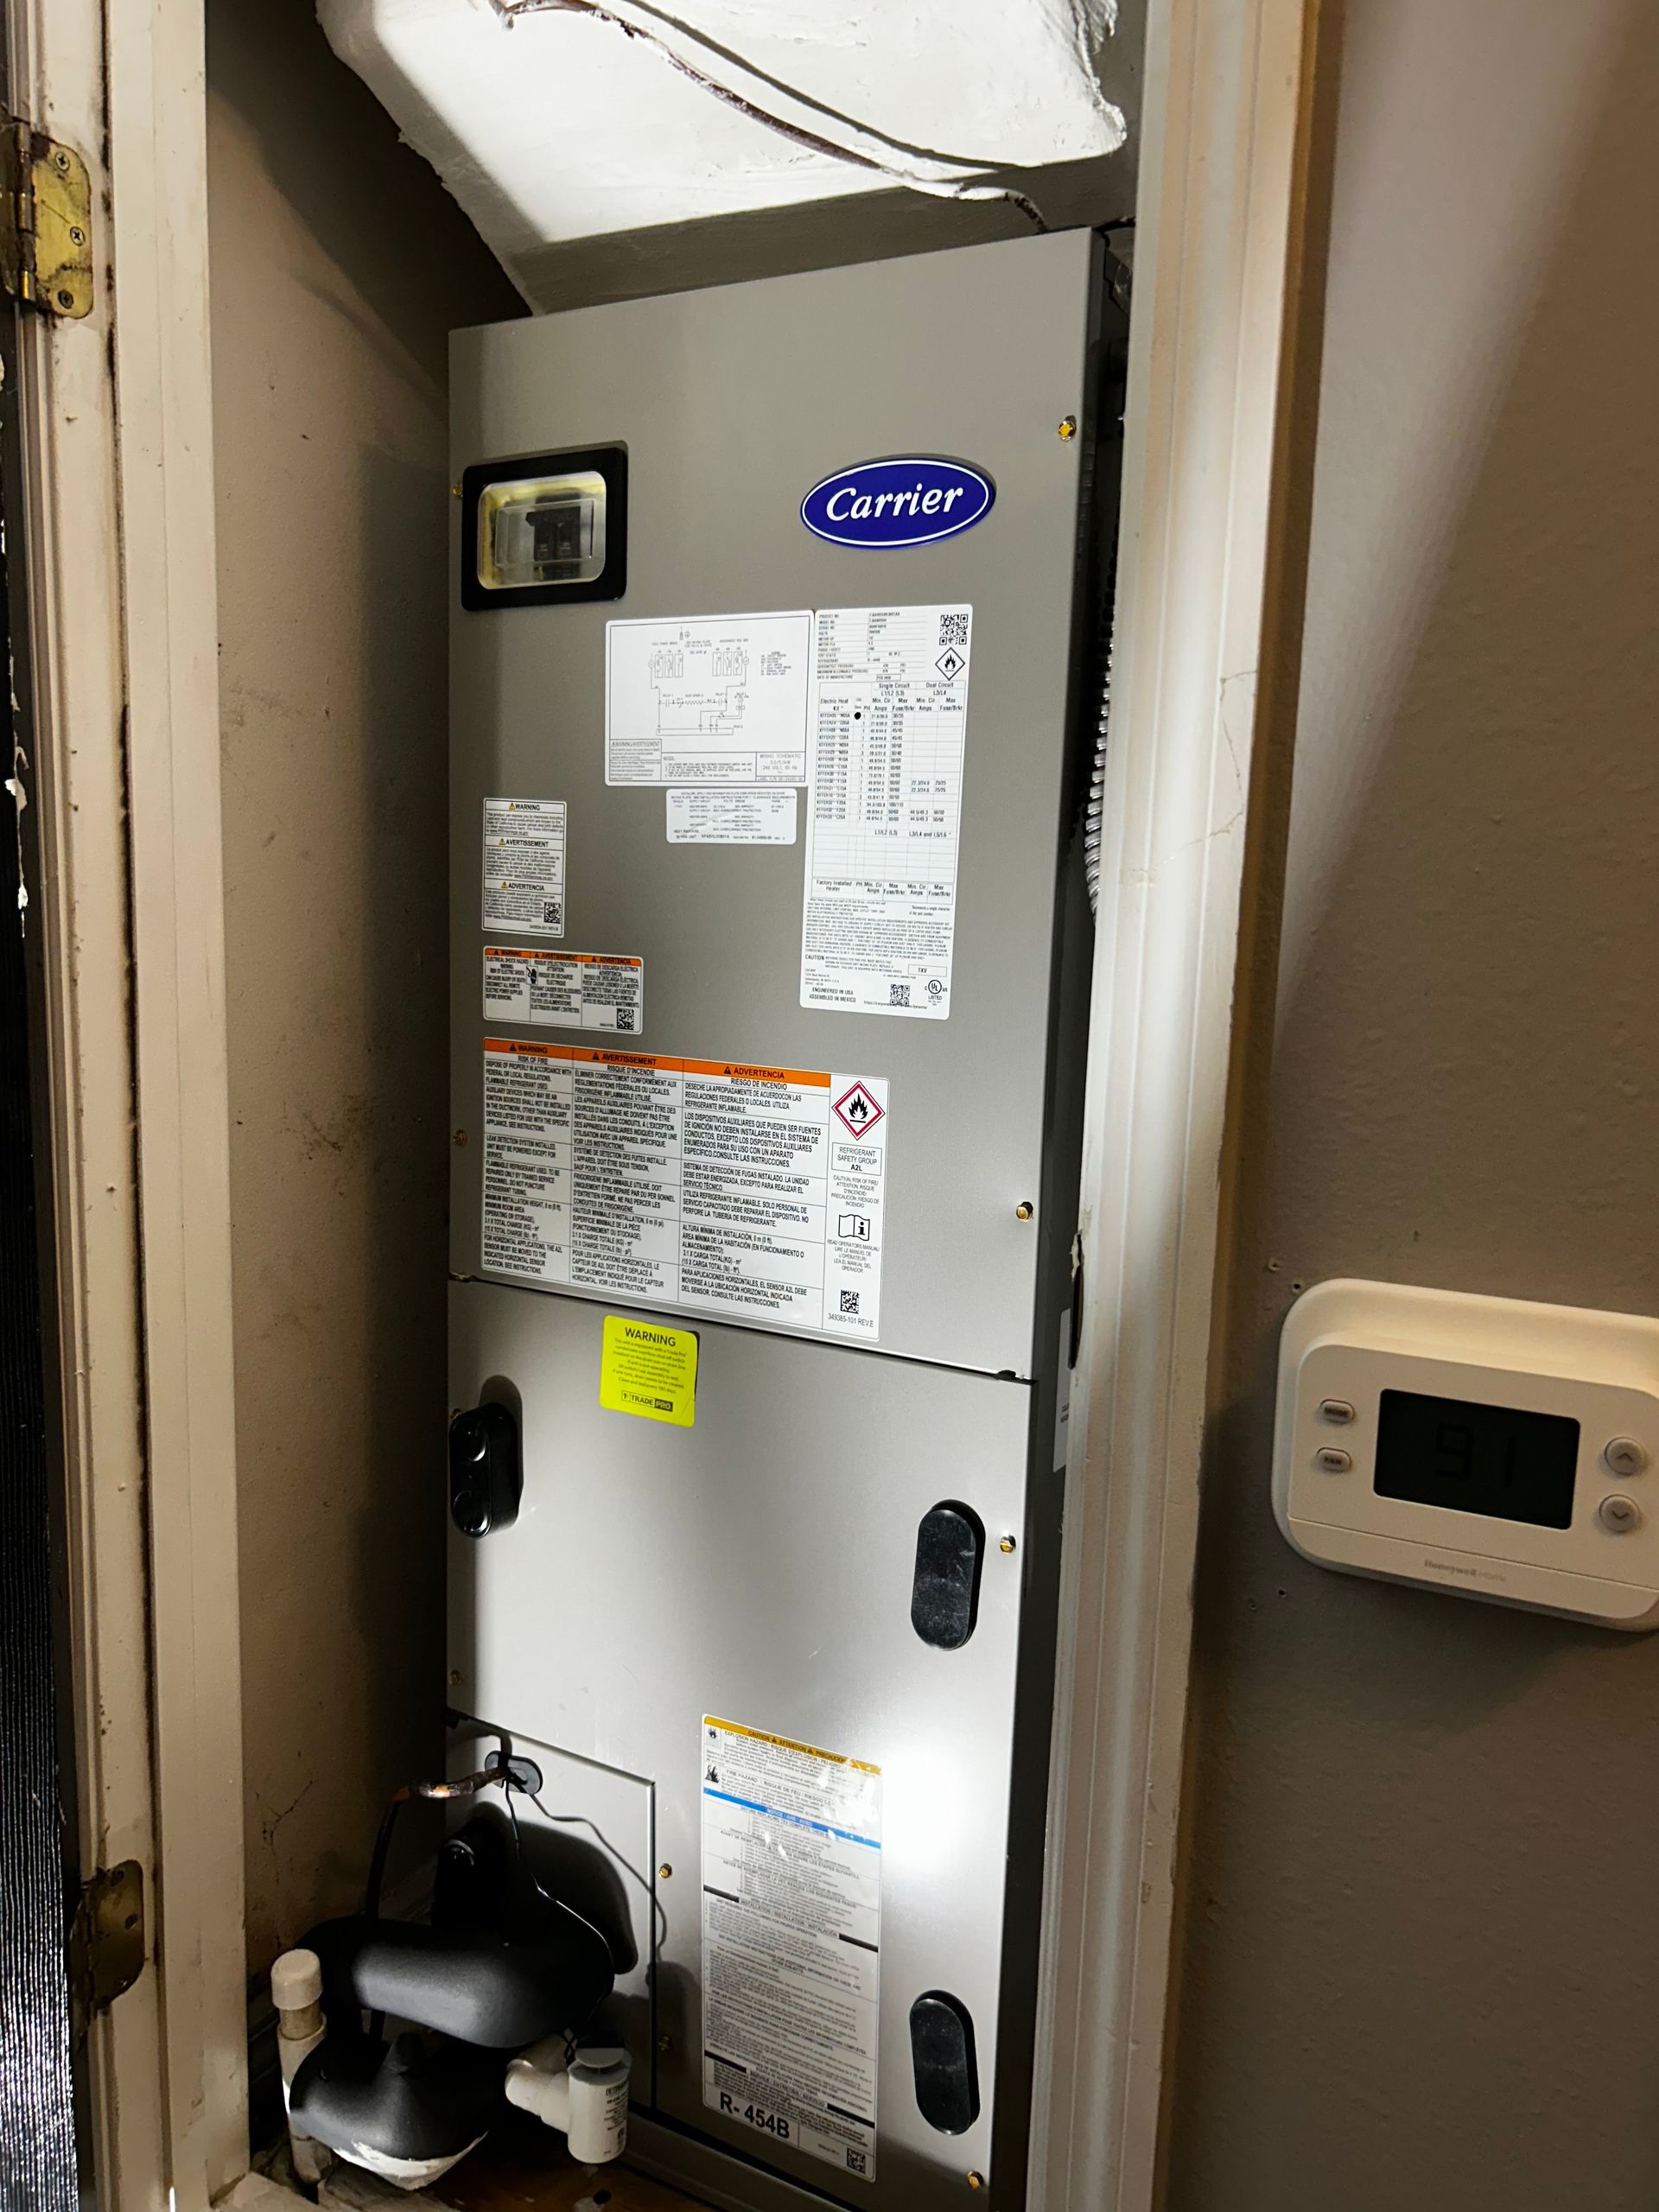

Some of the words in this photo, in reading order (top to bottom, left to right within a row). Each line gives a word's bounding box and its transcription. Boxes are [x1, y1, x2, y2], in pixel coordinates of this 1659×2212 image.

[827, 482, 963, 521] Carrier
[505, 838, 549, 848] AVERTISSEMENT
[508, 882, 544, 892] ADVERTENCIA
[931, 982, 938, 991] UL
[518, 1045, 547, 1053] WARNING
[601, 1052, 657, 1065] AVERTISSEMENT
[607, 1065, 626, 1073] RISQUE
[626, 1066, 655, 1076] D'INCENDIE
[734, 1067, 785, 1079] ADVERTENCIA
[730, 1077, 751, 1086] RIESGO
[760, 1081, 787, 1090] INCENDIO
[685, 1082, 705, 1091] DESECHE
[712, 1085, 752, 1096] APROPIADAMENTE
[760, 1090, 791, 1101] ACUERDOCON
[684, 1091, 718, 1101] REGULACIONES
[719, 1095, 745, 1104] FEDERALES
[772, 1101, 790, 1109] UTILIZA
[684, 1100, 717, 1109] REFRIGERANTE
[718, 1103, 747, 1113] INFLAMABLE.
[694, 1113, 727, 1124] DISPOSITIVOS
[727, 1117, 754, 1128] AUXILIARES
[766, 1122, 786, 1131] PUEDEN
[787, 1124, 798, 1133] SER
[798, 1125, 821, 1135] FUENTES
[722, 1125, 740, 1135] DEBEN
[741, 1128, 771, 1138] INSTALARSE
[772, 1131, 779, 1140] EN
[780, 1132, 786, 1141] EL
[787, 1133, 810, 1143] SISTEMA
[683, 1129, 715, 1141] CONDUCTOS,
[716, 1133, 738, 1143] EXCEPTO
[739, 1136, 749, 1145] LOS
[749, 1137, 782, 1148] DISPOSITIVOS
[783, 1141, 812, 1153] AUXILIARES
[683, 1138, 715, 1149] ENUMERADOS
[716, 1142, 729, 1151] PARA
[749, 1146, 760, 1154] CON
[769, 1148, 793, 1159] APARATO
[839, 1146, 875, 1157] REFRIGERANT
[740, 1154, 750, 1162] LAS
[837, 1154, 857, 1163] SAFETY
[857, 1156, 877, 1166] GROUP
[624, 1327, 676, 1346] WARNING
[631, 1394, 653, 1405] TRADE
[655, 1400, 671, 1409] PRO
[1425, 1559, 1477, 1576] Honeywell
[720, 2091, 740, 2118] R-
[744, 2101, 789, 2140] 454B
